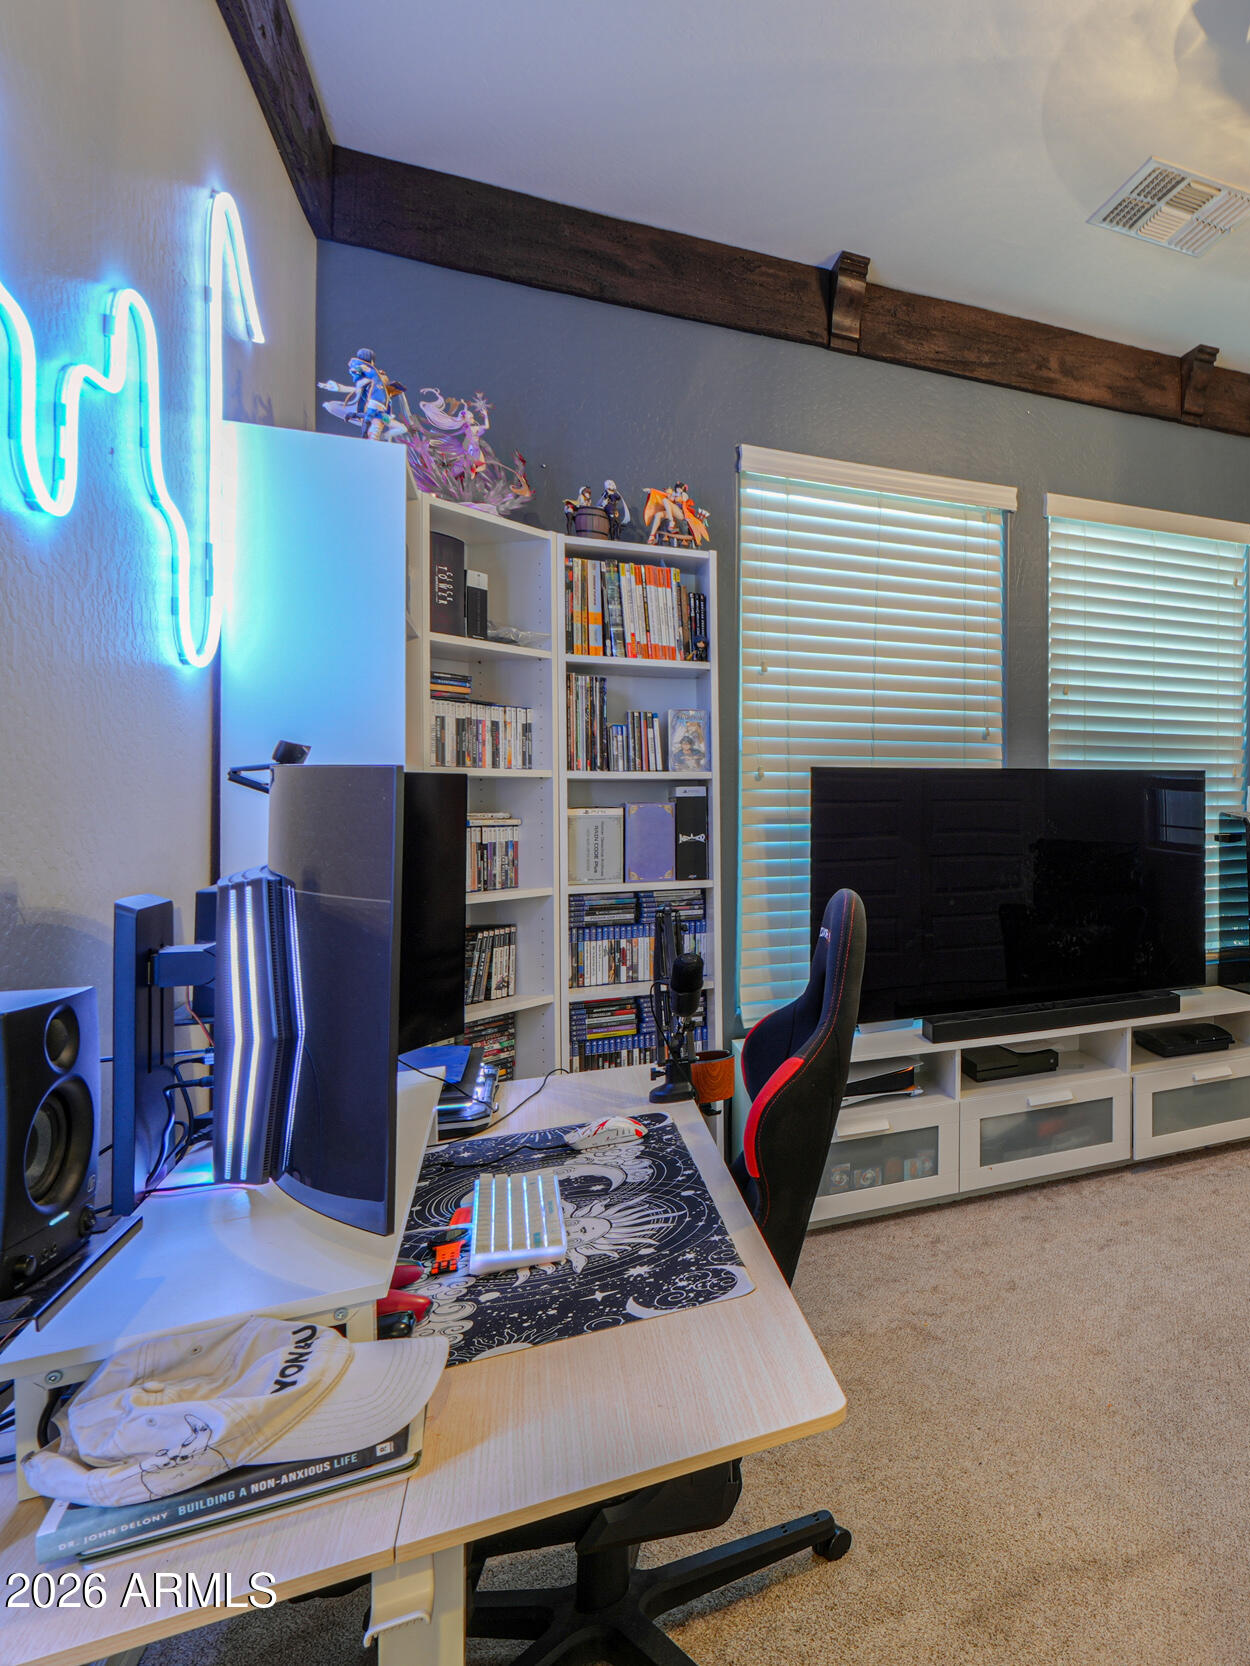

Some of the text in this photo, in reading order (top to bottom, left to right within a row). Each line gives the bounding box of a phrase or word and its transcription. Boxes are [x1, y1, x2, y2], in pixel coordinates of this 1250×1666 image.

[177, 1452, 359, 1517] BUILDING A NON-ANXIOUS LIFE
[58, 1511, 168, 1551] DR. JOHN DELONY
